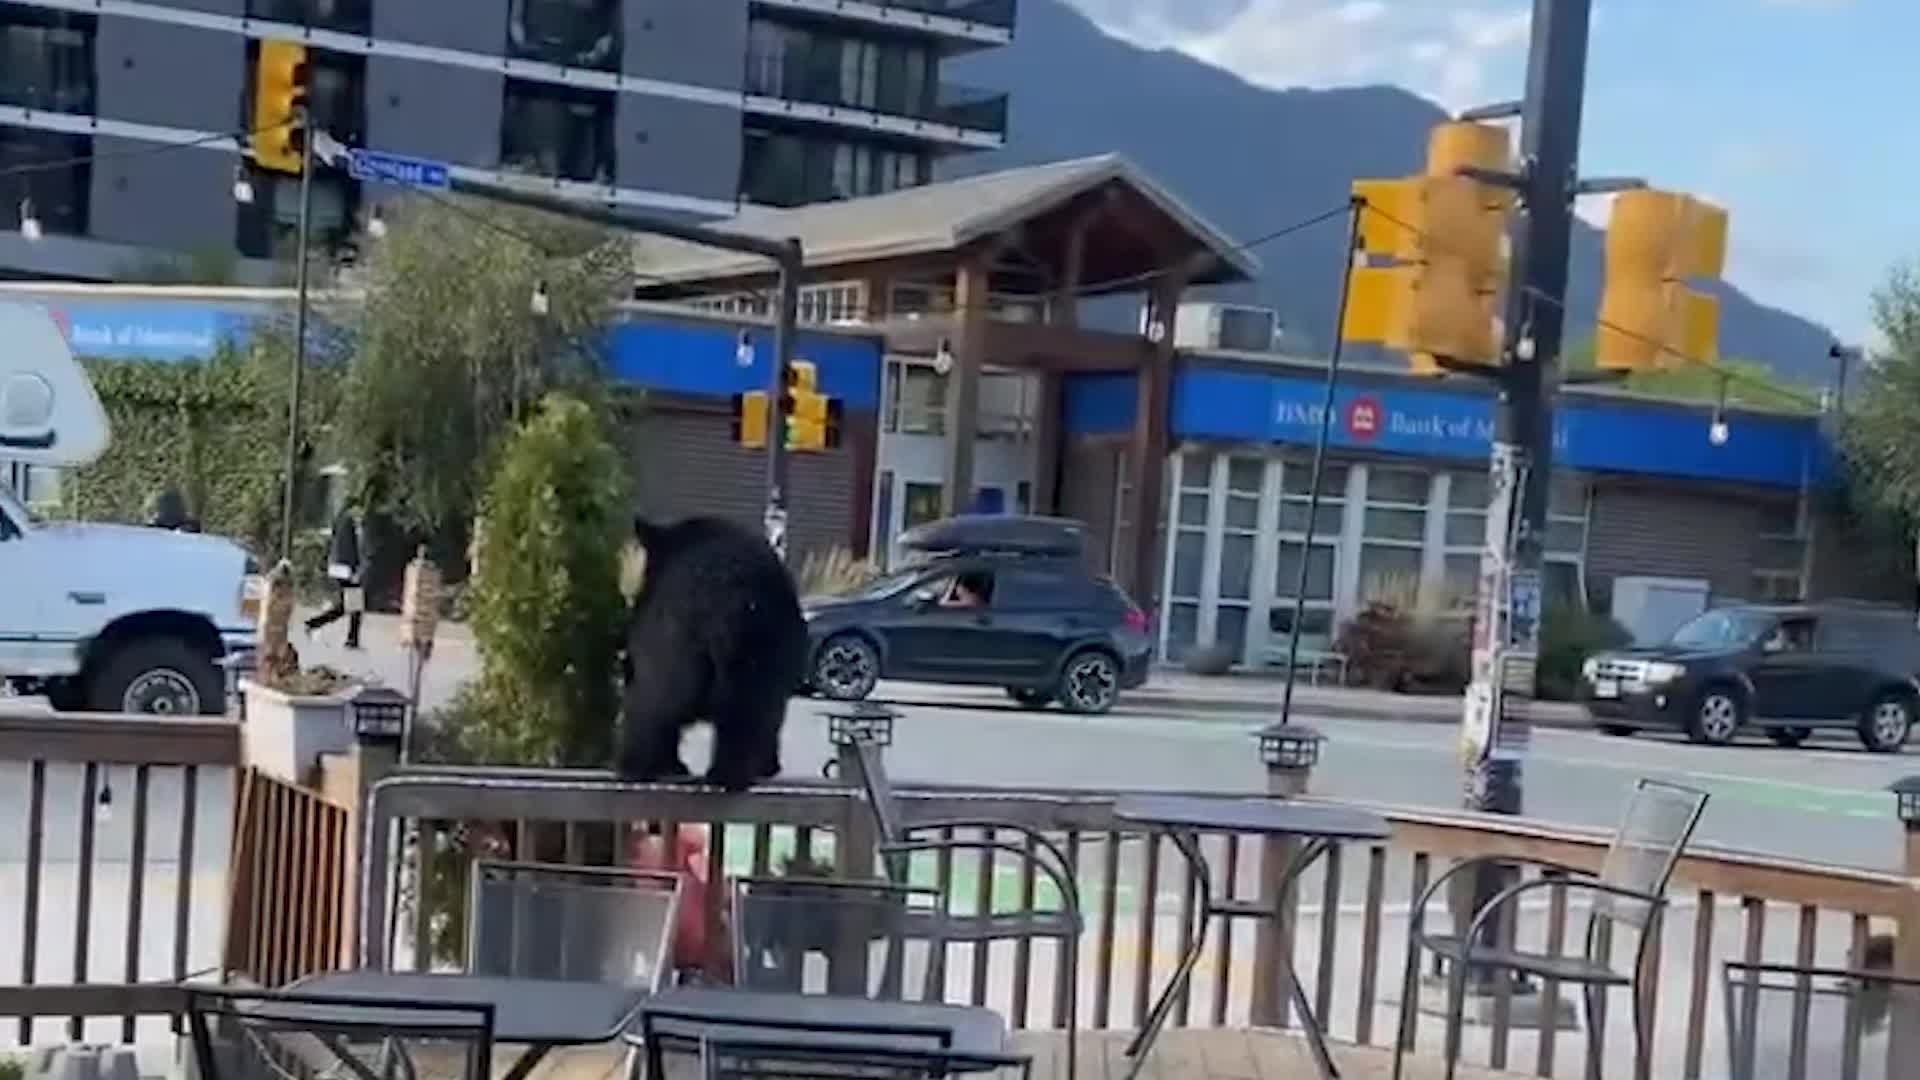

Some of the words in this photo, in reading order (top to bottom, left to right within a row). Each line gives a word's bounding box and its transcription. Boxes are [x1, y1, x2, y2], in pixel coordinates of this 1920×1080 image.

[1274, 399, 1337, 425] BMO
[1391, 411, 1444, 437] Bank
[1448, 415, 1471, 439] of
